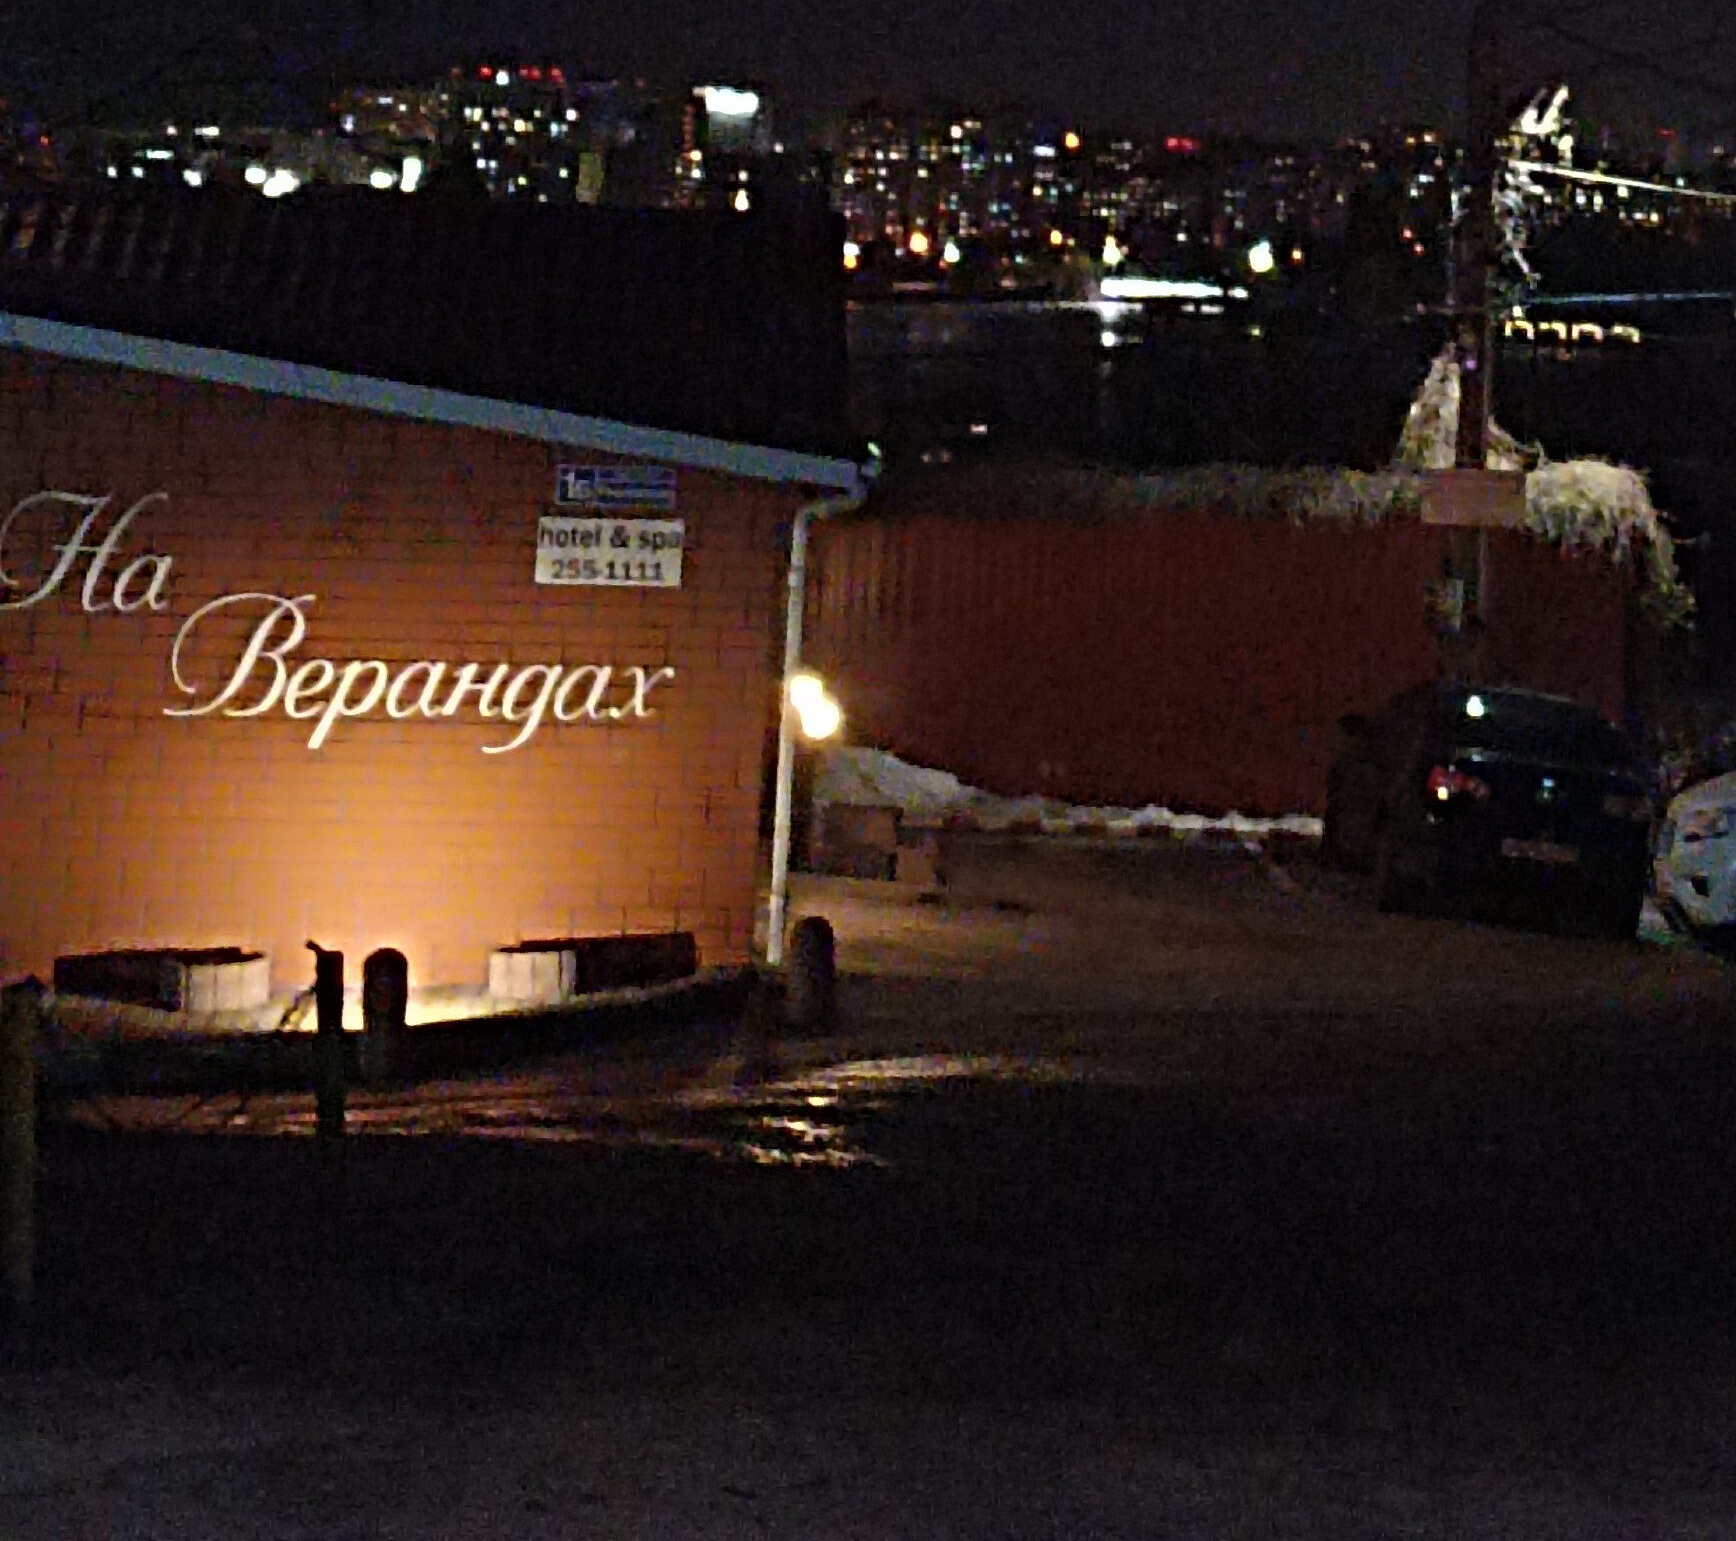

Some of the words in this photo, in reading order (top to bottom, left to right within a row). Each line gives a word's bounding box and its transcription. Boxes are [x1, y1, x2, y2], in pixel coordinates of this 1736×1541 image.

[0, 490, 172, 612] На
[539, 524, 603, 548] hotel
[610, 525, 630, 548] &
[639, 529, 681, 554] spa
[163, 591, 676, 754] Верандах
